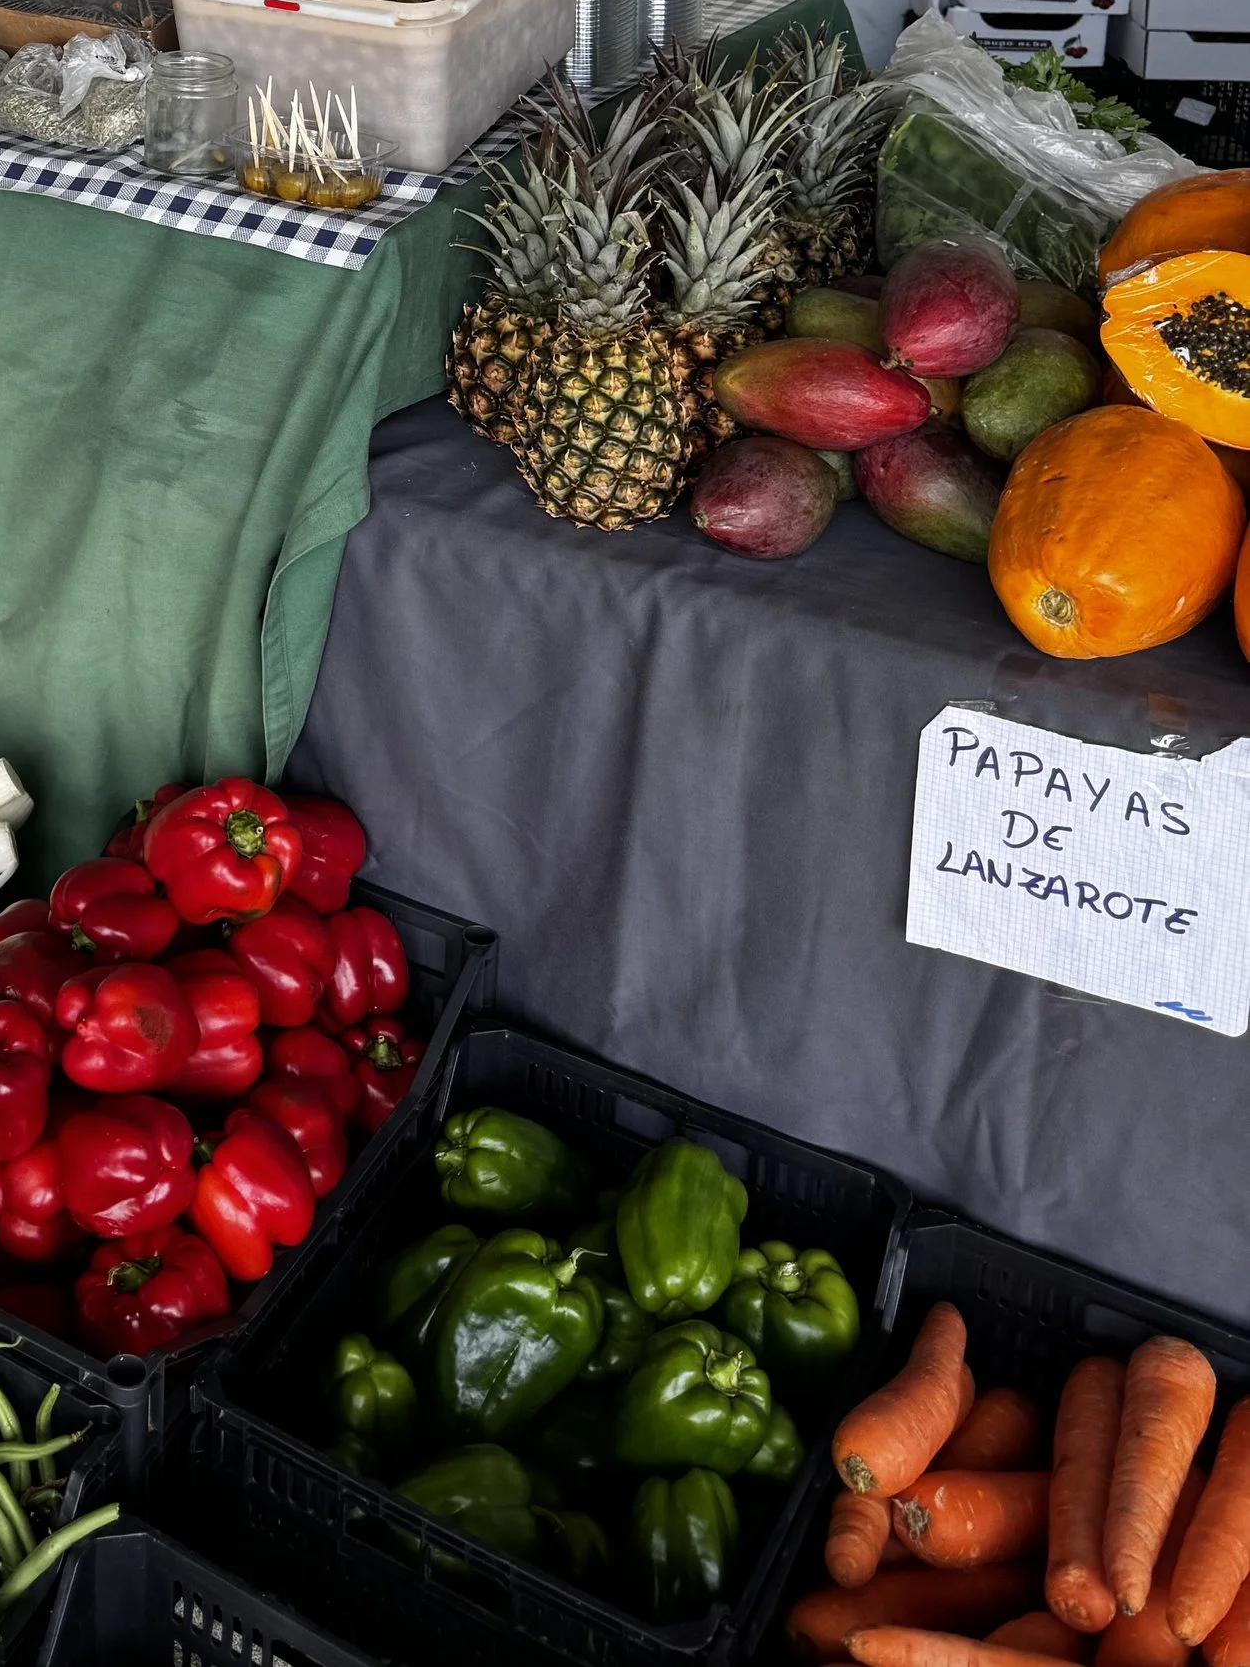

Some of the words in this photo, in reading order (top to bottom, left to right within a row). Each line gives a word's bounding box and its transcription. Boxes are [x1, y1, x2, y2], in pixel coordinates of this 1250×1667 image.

[942, 726, 1191, 836] PAPAYAS
[1001, 809, 1073, 851] DE
[936, 841, 1198, 935] LANZAROTE
